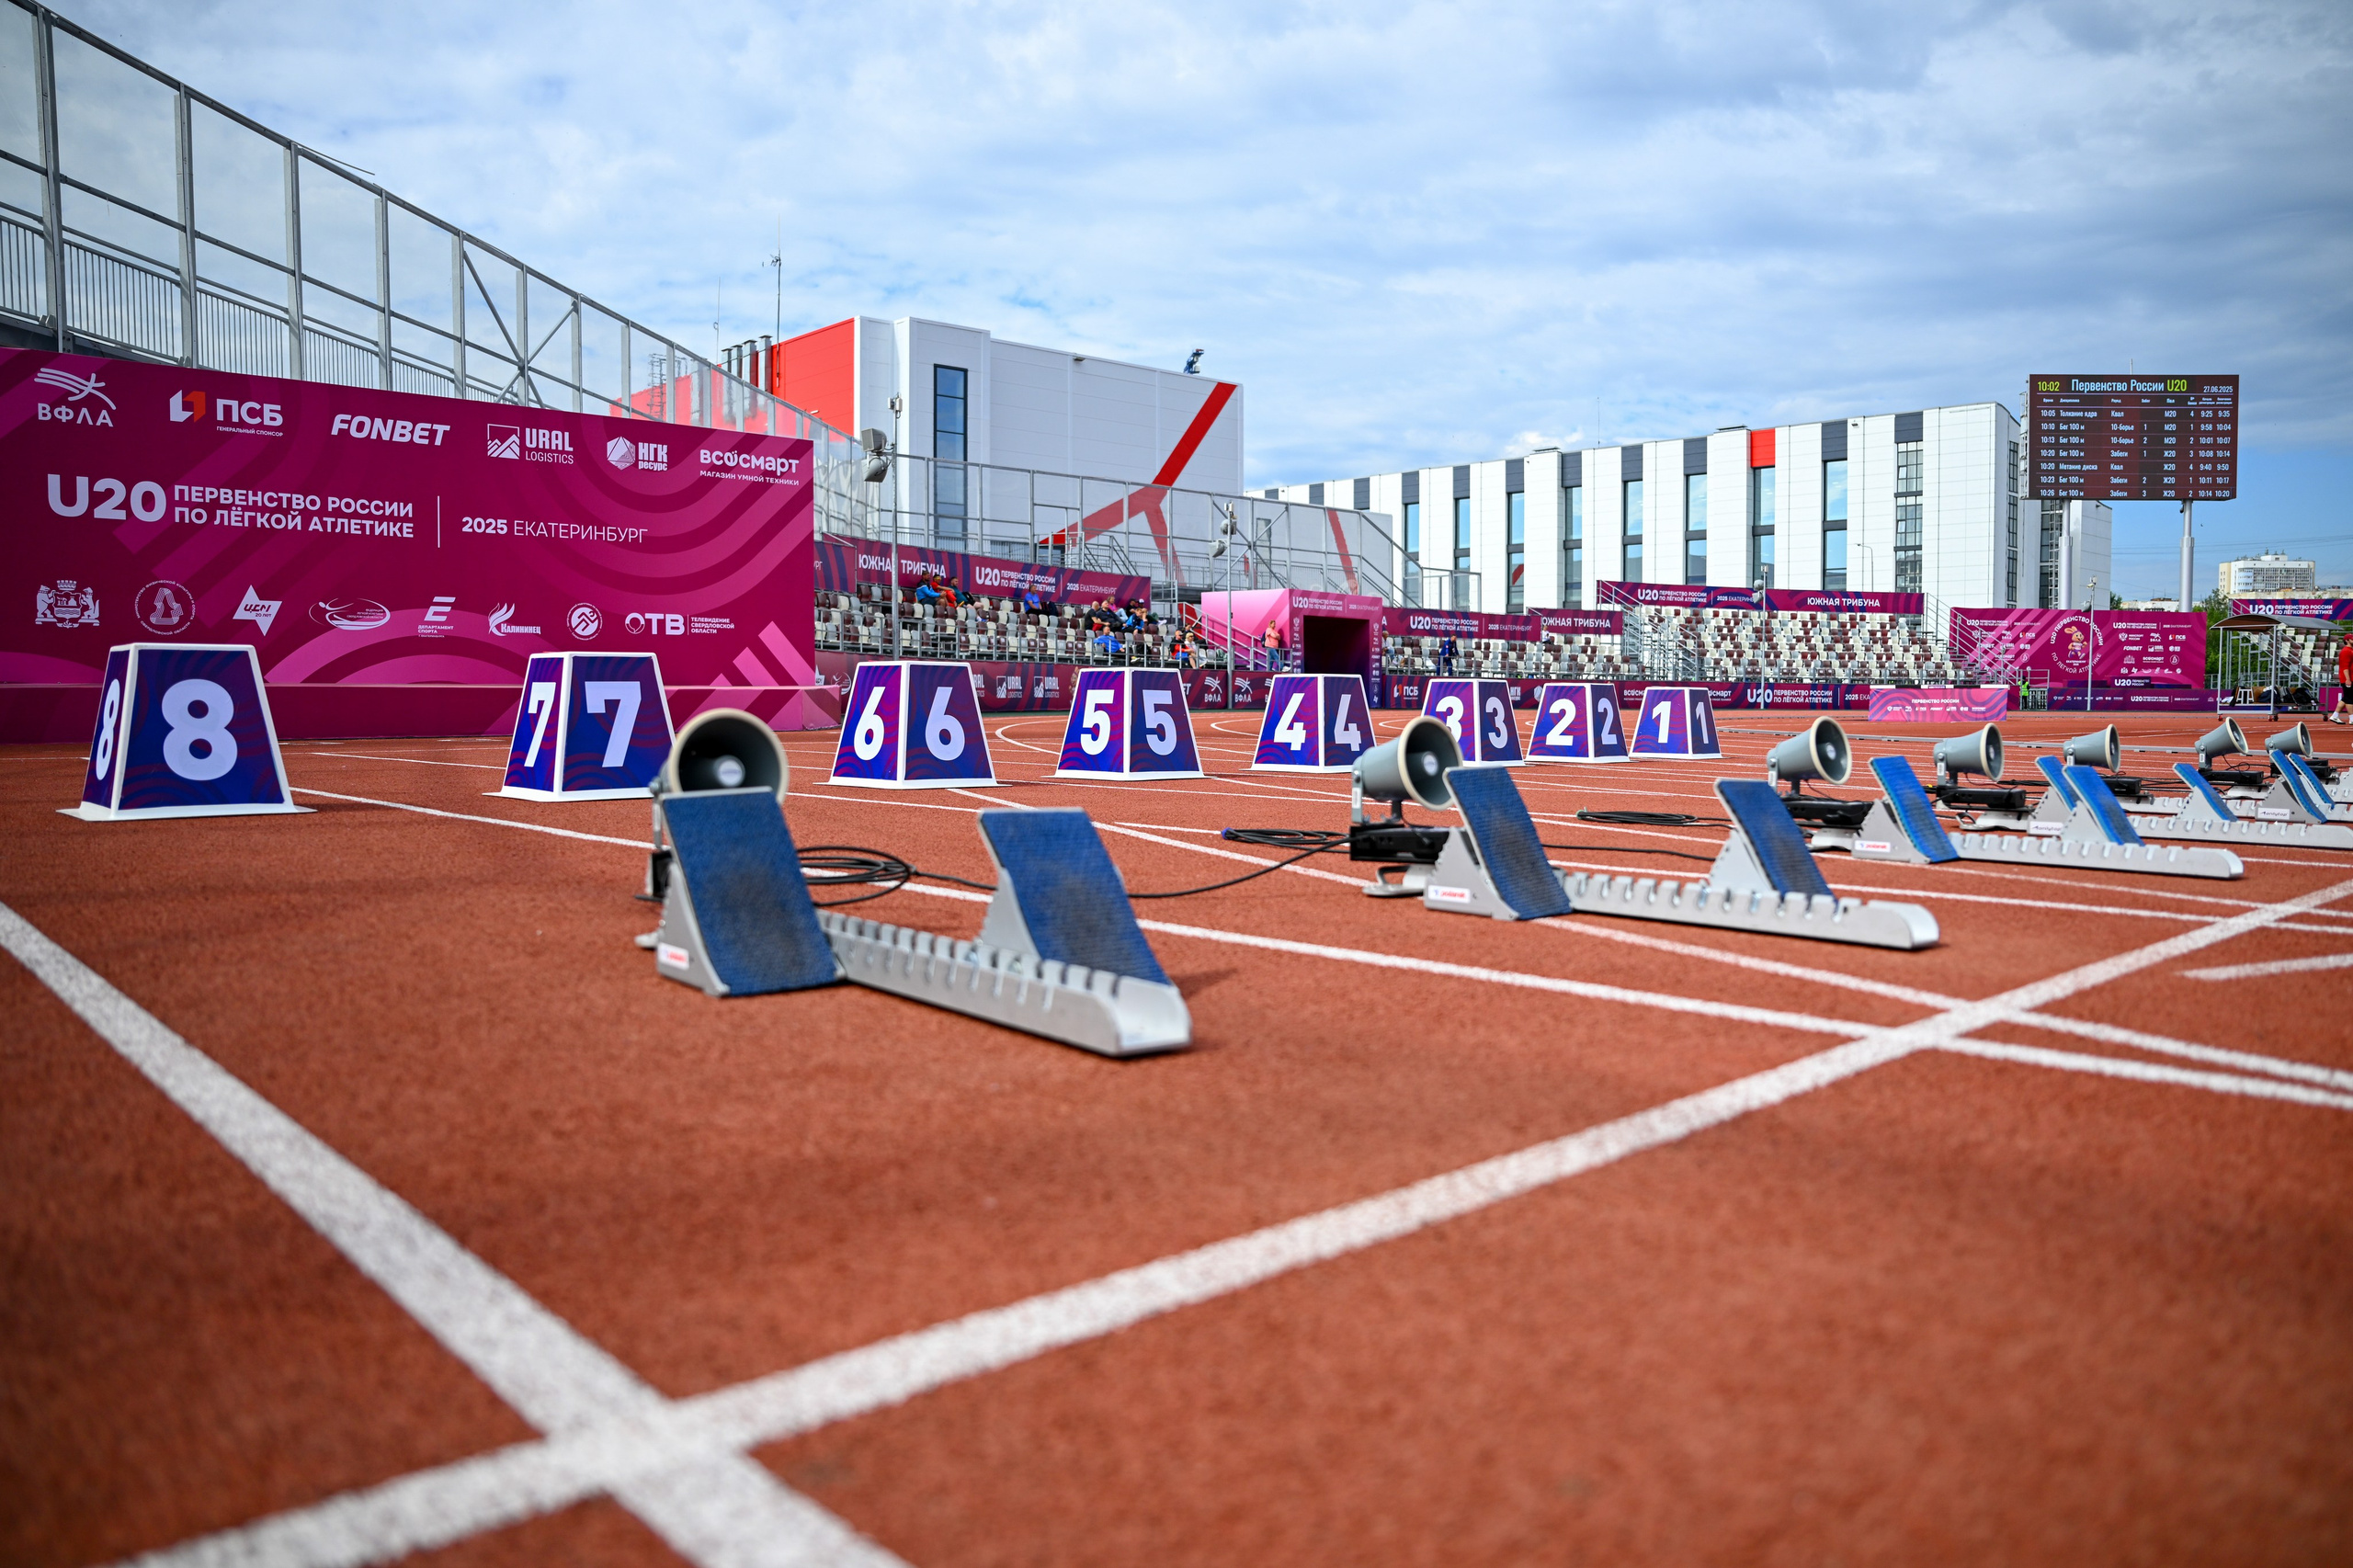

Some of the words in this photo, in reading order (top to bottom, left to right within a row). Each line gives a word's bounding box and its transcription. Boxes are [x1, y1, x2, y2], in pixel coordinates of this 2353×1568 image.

[2037, 381, 2060, 392] 10:02
[2071, 379, 2128, 393] Первенство
[2130, 379, 2165, 392] России
[2166, 379, 2188, 392] U20
[2203, 385, 2234, 393] 27.06.2025
[38, 403, 114, 427] ВФЛА
[216, 398, 284, 426] ПСБ
[216, 426, 256, 435] ГЕНЕРАЛЬНЫЙ
[256, 429, 284, 437] СПОНСОР
[331, 414, 451, 447] FONBET
[525, 427, 574, 451] URAL
[525, 450, 574, 465] LOGISTICS
[638, 441, 668, 462] НГК
[638, 460, 668, 472] ресурс
[699, 470, 736, 480] МАГАЗИН
[737, 473, 765, 483] УМНОЙ
[765, 477, 800, 486] ТЕХНИКИ
[47, 473, 167, 523] U20
[174, 484, 321, 511] ПЕРВЕНСТВО
[327, 495, 414, 518] РОССИИ
[174, 506, 208, 525] ПО
[214, 506, 302, 531] ЛЁГКОЙ
[309, 517, 415, 539] АТЛЕТИКЕ
[461, 516, 508, 535] 2025
[514, 520, 648, 543] ЕКАТЕРИНБУРГ
[975, 566, 1001, 587] U20
[1001, 570, 1034, 581] ПЕРВЕНСТВО
[1034, 574, 1056, 585] РОССИИ
[1001, 579, 1009, 587] ПО
[1009, 579, 1029, 590] ЛЁГКОЙ
[1066, 583, 1079, 591] 2025
[1080, 584, 1117, 596] ЕКАТЕРИНБУРГ
[1637, 588, 1658, 600] U20
[1292, 597, 1309, 608] U20
[1807, 597, 1840, 607] ЮЖНАЯ
[1842, 597, 1881, 608] ТРИБУНА
[2249, 604, 2274, 615] U20
[624, 612, 686, 636] ОТВ
[1409, 615, 1431, 630] U20
[1431, 617, 1460, 625] ПЕРВЕНСТВО
[1438, 623, 1456, 631] ЛЁГКОЙ
[1499, 624, 1533, 632] ЕКАТЕРИНБУРГ
[1574, 618, 1611, 629] ТРИБУНА
[2054, 615, 2090, 632] ПЕРВЕНСТВО
[1006, 676, 1022, 689] URAL
[1044, 676, 1060, 690] URAL
[1403, 686, 1419, 697] ПСБ
[2114, 678, 2131, 687] U20
[1204, 693, 1222, 703] ВФЛА
[1234, 693, 1252, 703] ВФЛА
[1746, 688, 1773, 703] U20
[96, 678, 120, 780] 8
[161, 678, 238, 781] 8
[527, 681, 557, 767] 7
[585, 680, 642, 767] 7
[853, 686, 886, 761] 6
[925, 686, 966, 762] 6
[1079, 688, 1115, 756] 5
[1142, 689, 1177, 756] 5
[1273, 692, 1307, 751] 4
[1334, 694, 1362, 752] 4
[1436, 696, 1464, 743] 3
[1485, 697, 1507, 749] 3
[1546, 698, 1577, 747] 2
[1597, 697, 1619, 747] 2
[1652, 700, 1672, 744] 1
[1695, 701, 1710, 744] 1
